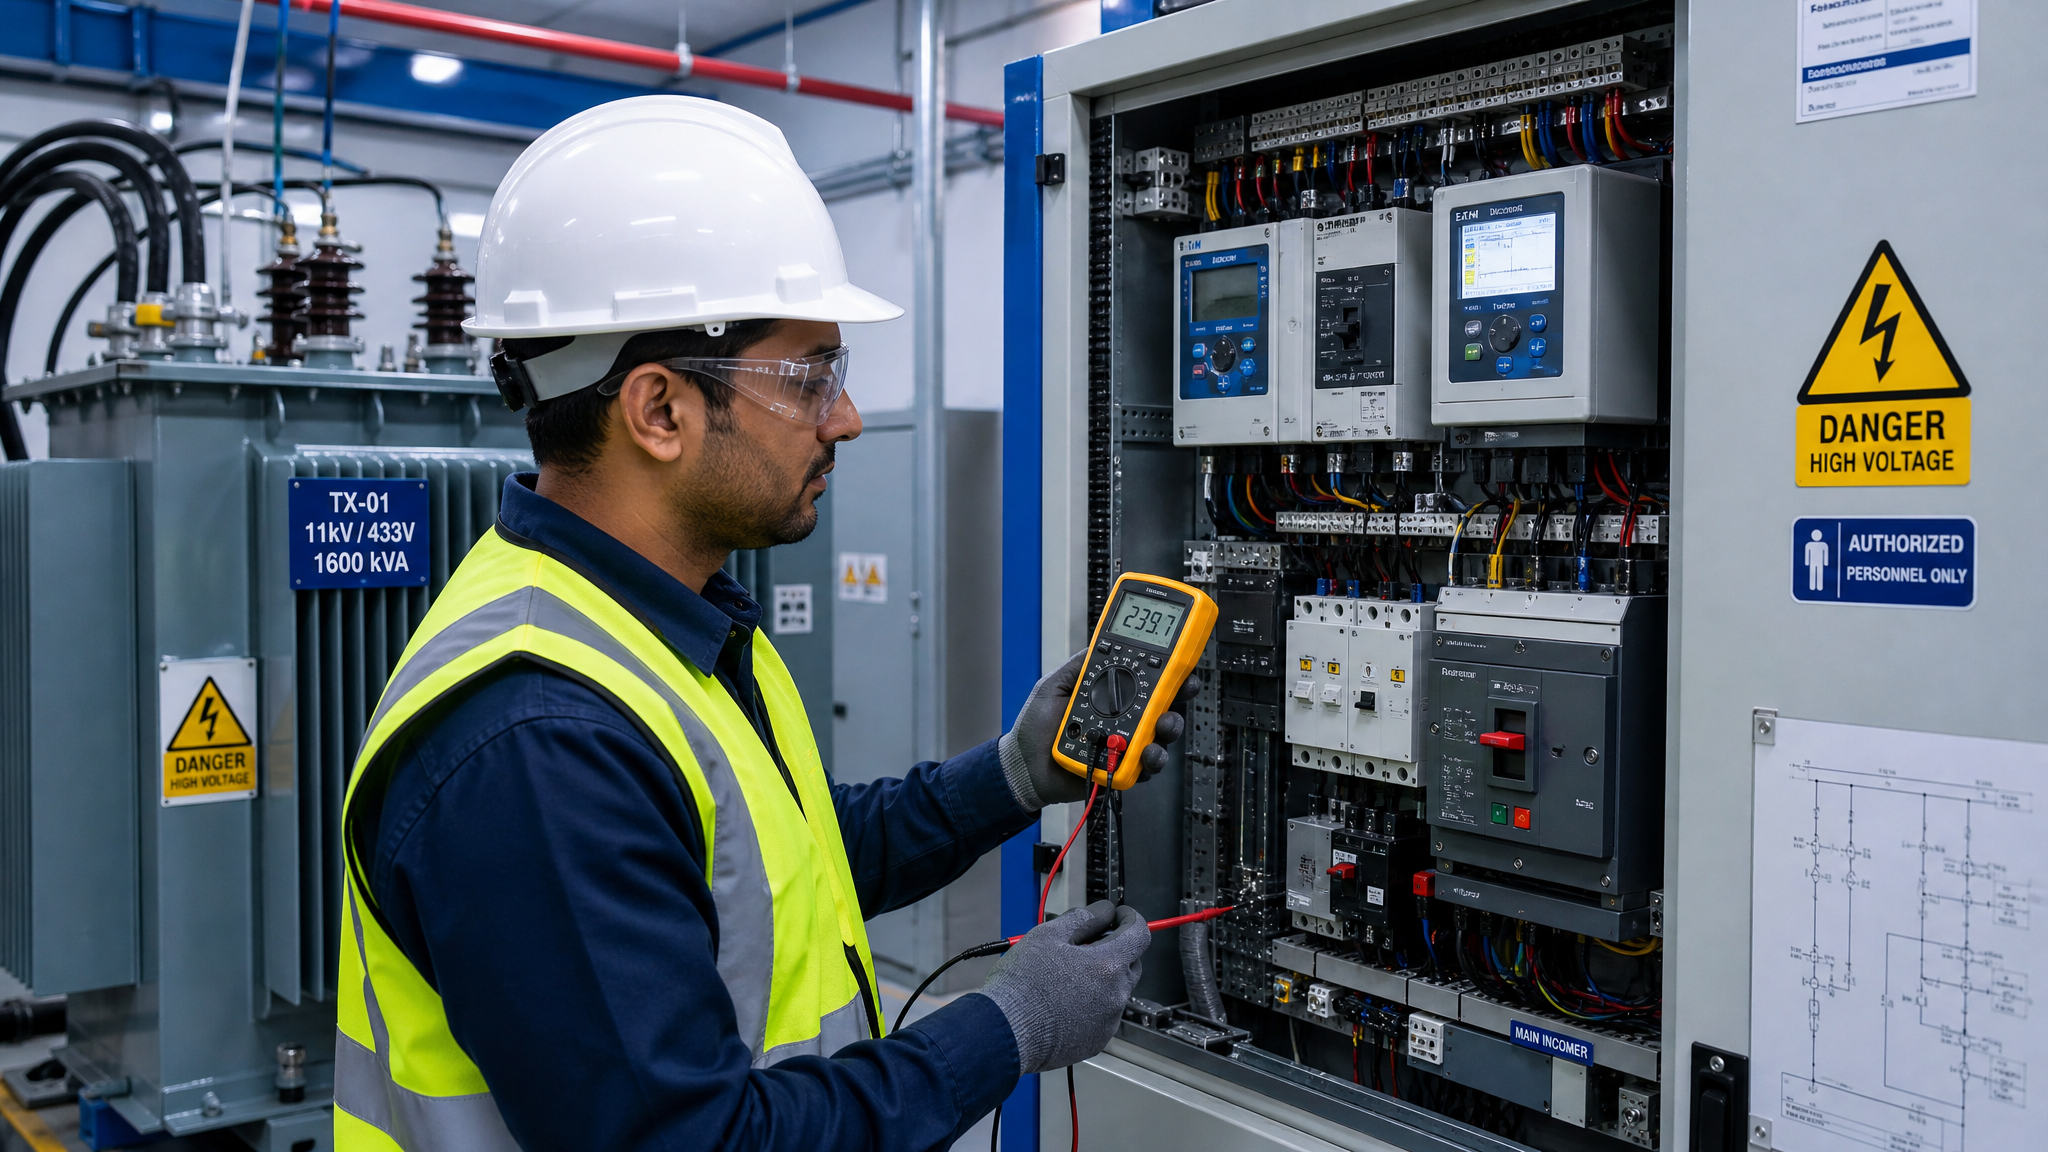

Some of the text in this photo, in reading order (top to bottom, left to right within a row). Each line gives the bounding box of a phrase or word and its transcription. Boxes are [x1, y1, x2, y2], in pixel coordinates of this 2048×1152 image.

[1820, 410, 1945, 444] DANGER
[1810, 450, 1954, 473] HIGH VOLTAGE
[329, 492, 388, 513] TX-01
[1848, 534, 1964, 554] AUTHORIZED
[314, 551, 409, 573] 1600 kVA
[1847, 566, 1968, 584] PERSONNEL ONLY
[1122, 605, 1176, 637] 239.7
[176, 752, 246, 774] DANGER
[170, 772, 250, 791] HIGH VOLTAGE
[1515, 1026, 1588, 1059] MAIN INCOMER
